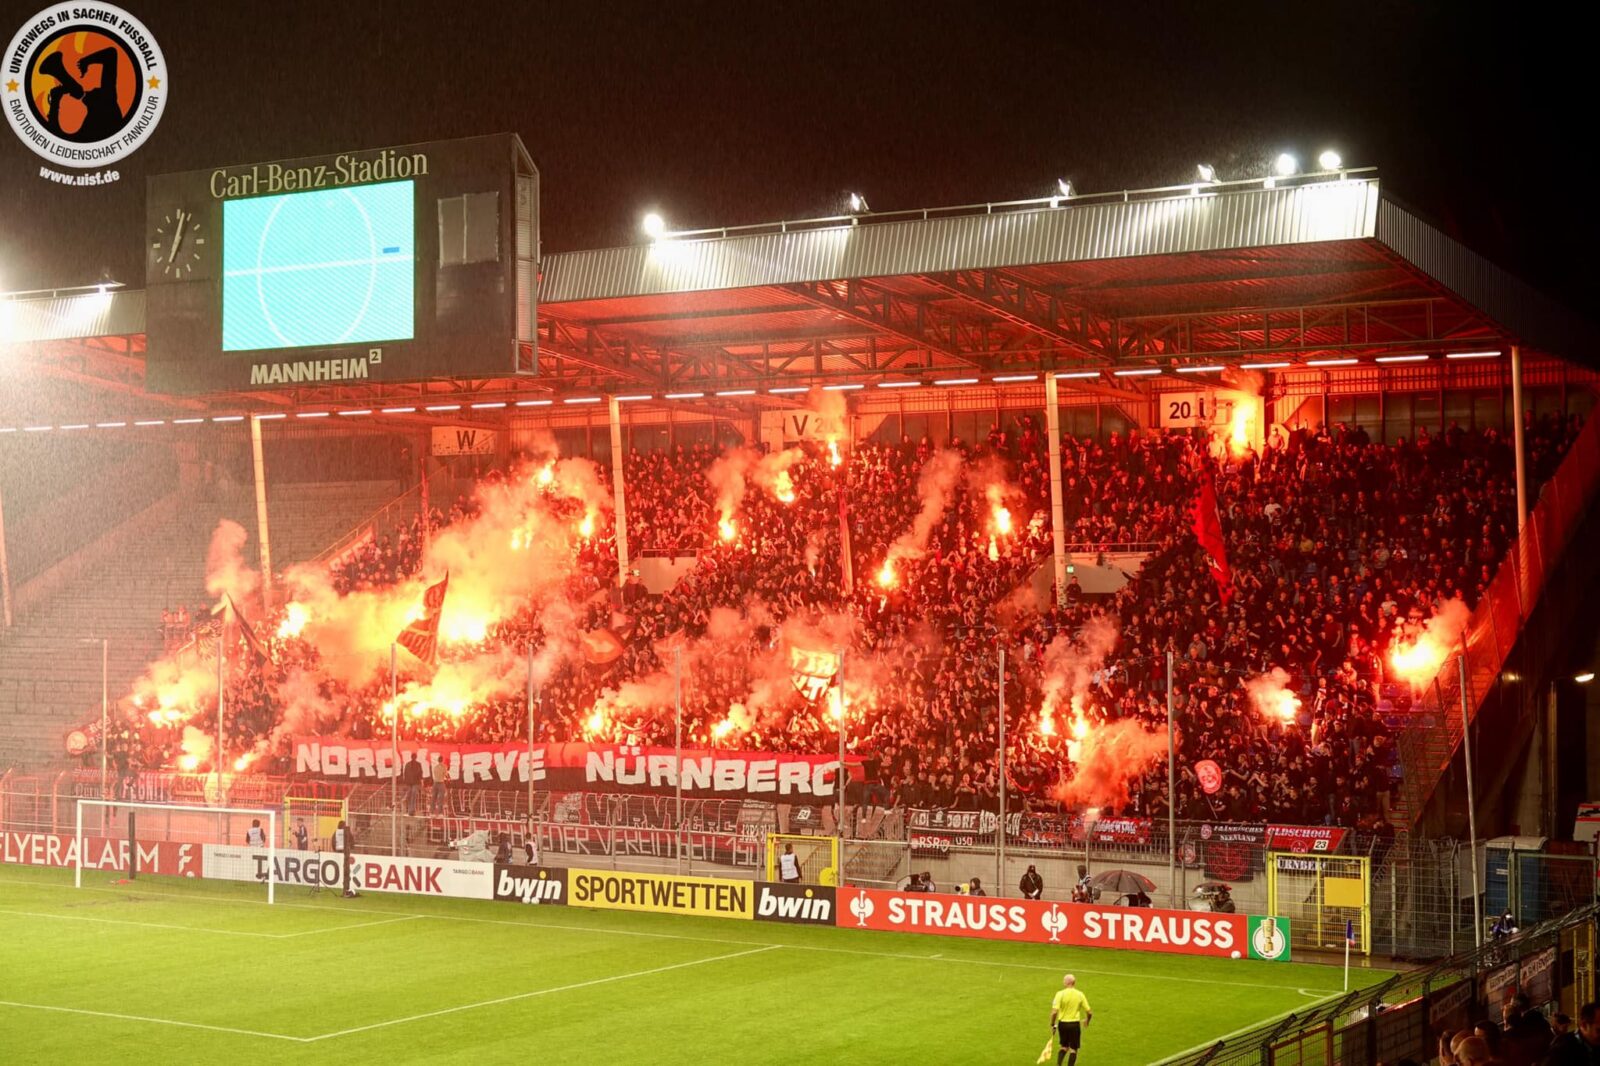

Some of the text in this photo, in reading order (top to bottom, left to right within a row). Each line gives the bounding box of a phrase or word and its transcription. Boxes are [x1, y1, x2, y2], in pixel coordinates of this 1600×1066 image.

[210, 150, 429, 198] Carl-Benz-Stadion
[250, 357, 368, 385] MANNHEIM
[1169, 401, 1191, 420] 20
[456, 429, 476, 450] W
[793, 415, 808, 436] V
[1267, 827, 1332, 838] OLDSCHOOL
[1315, 841, 1327, 849] 23
[497, 869, 562, 900] bwin
[575, 875, 747, 913] SPORTWETTEN
[758, 887, 831, 921] bwin
[888, 898, 1027, 934] STRAUSS
[1083, 911, 1235, 948] STRAUSS
